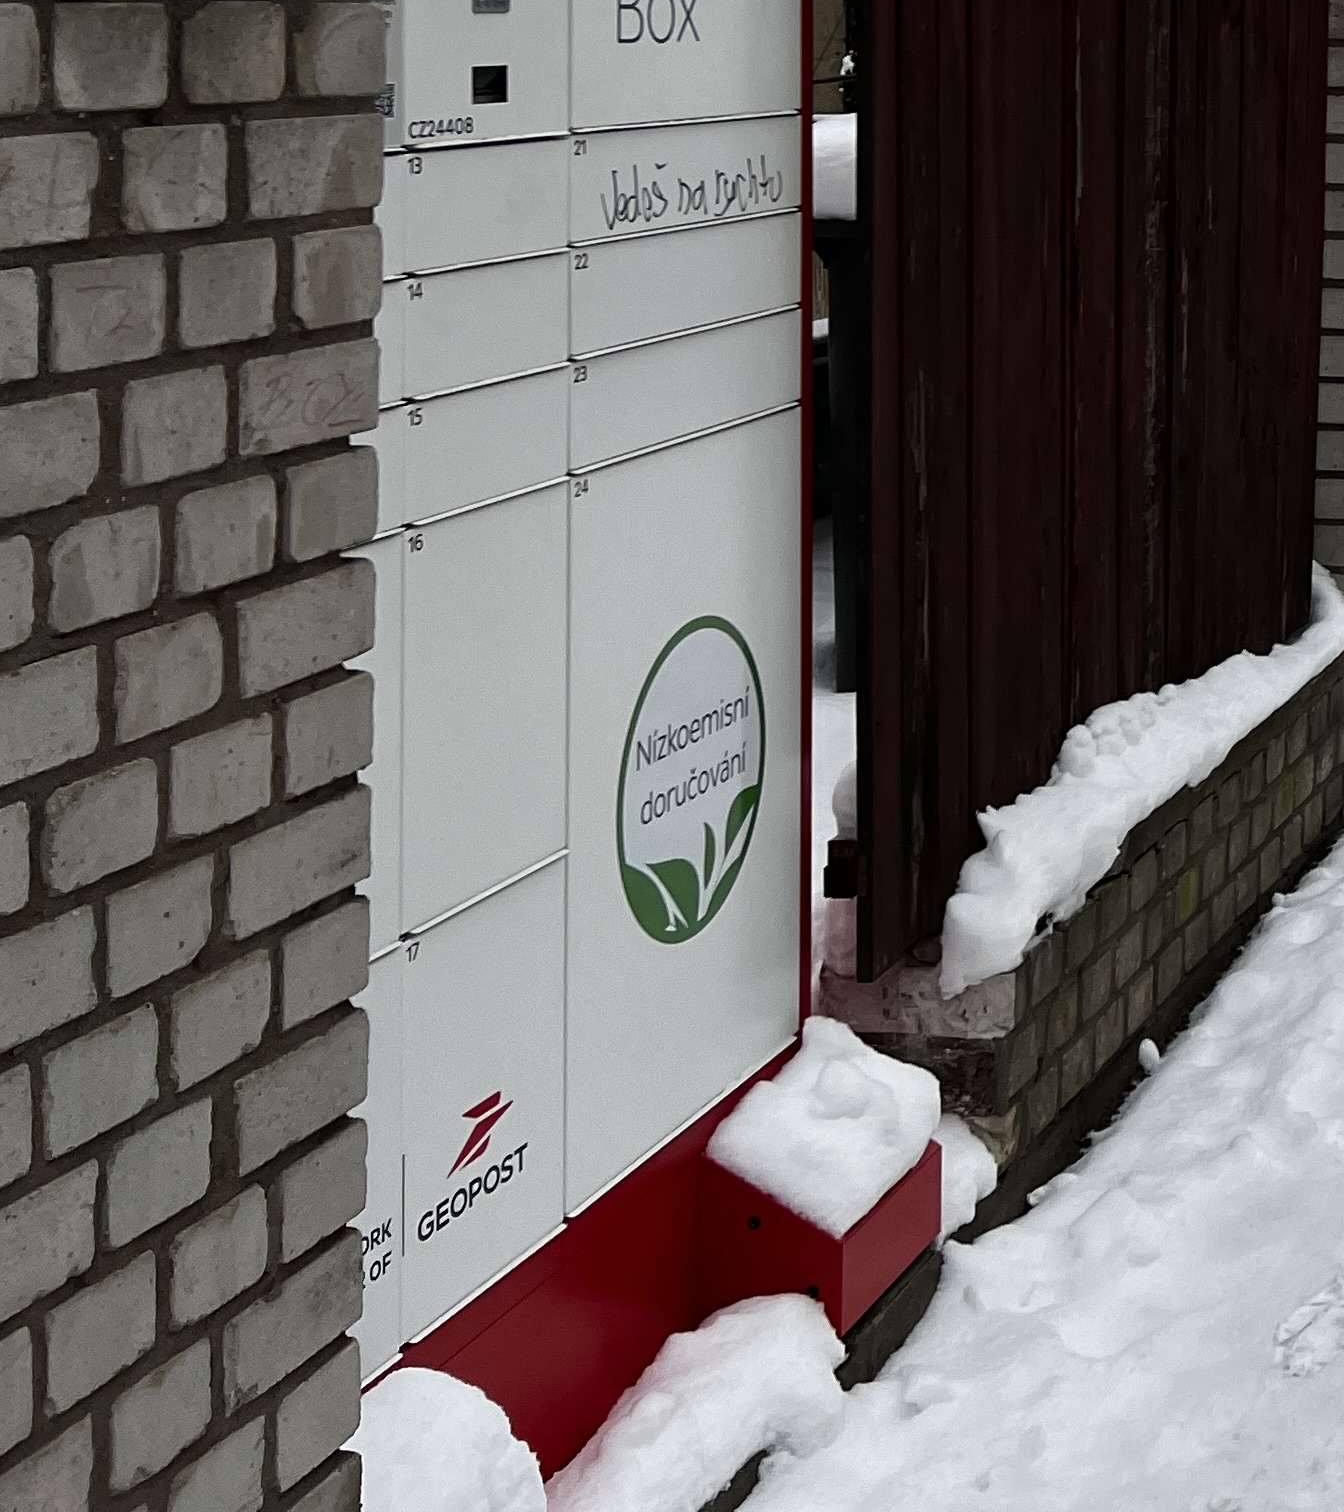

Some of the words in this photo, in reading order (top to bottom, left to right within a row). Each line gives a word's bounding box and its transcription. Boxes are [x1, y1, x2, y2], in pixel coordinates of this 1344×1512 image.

[408, 117, 474, 138] CZ24408
[573, 140, 587, 156] 21
[408, 157, 423, 175] 13
[573, 253, 589, 270] 22
[407, 283, 423, 300] 14
[573, 366, 588, 383] 23
[407, 408, 423, 426] 15
[573, 479, 589, 498] 24
[407, 534, 424, 552] 16
[636, 685, 750, 772] Nízkoemisní
[640, 741, 747, 825] doručování
[405, 941, 420, 962] 17
[417, 1141, 529, 1242] GEOPOST
[369, 1250, 393, 1281] OF
